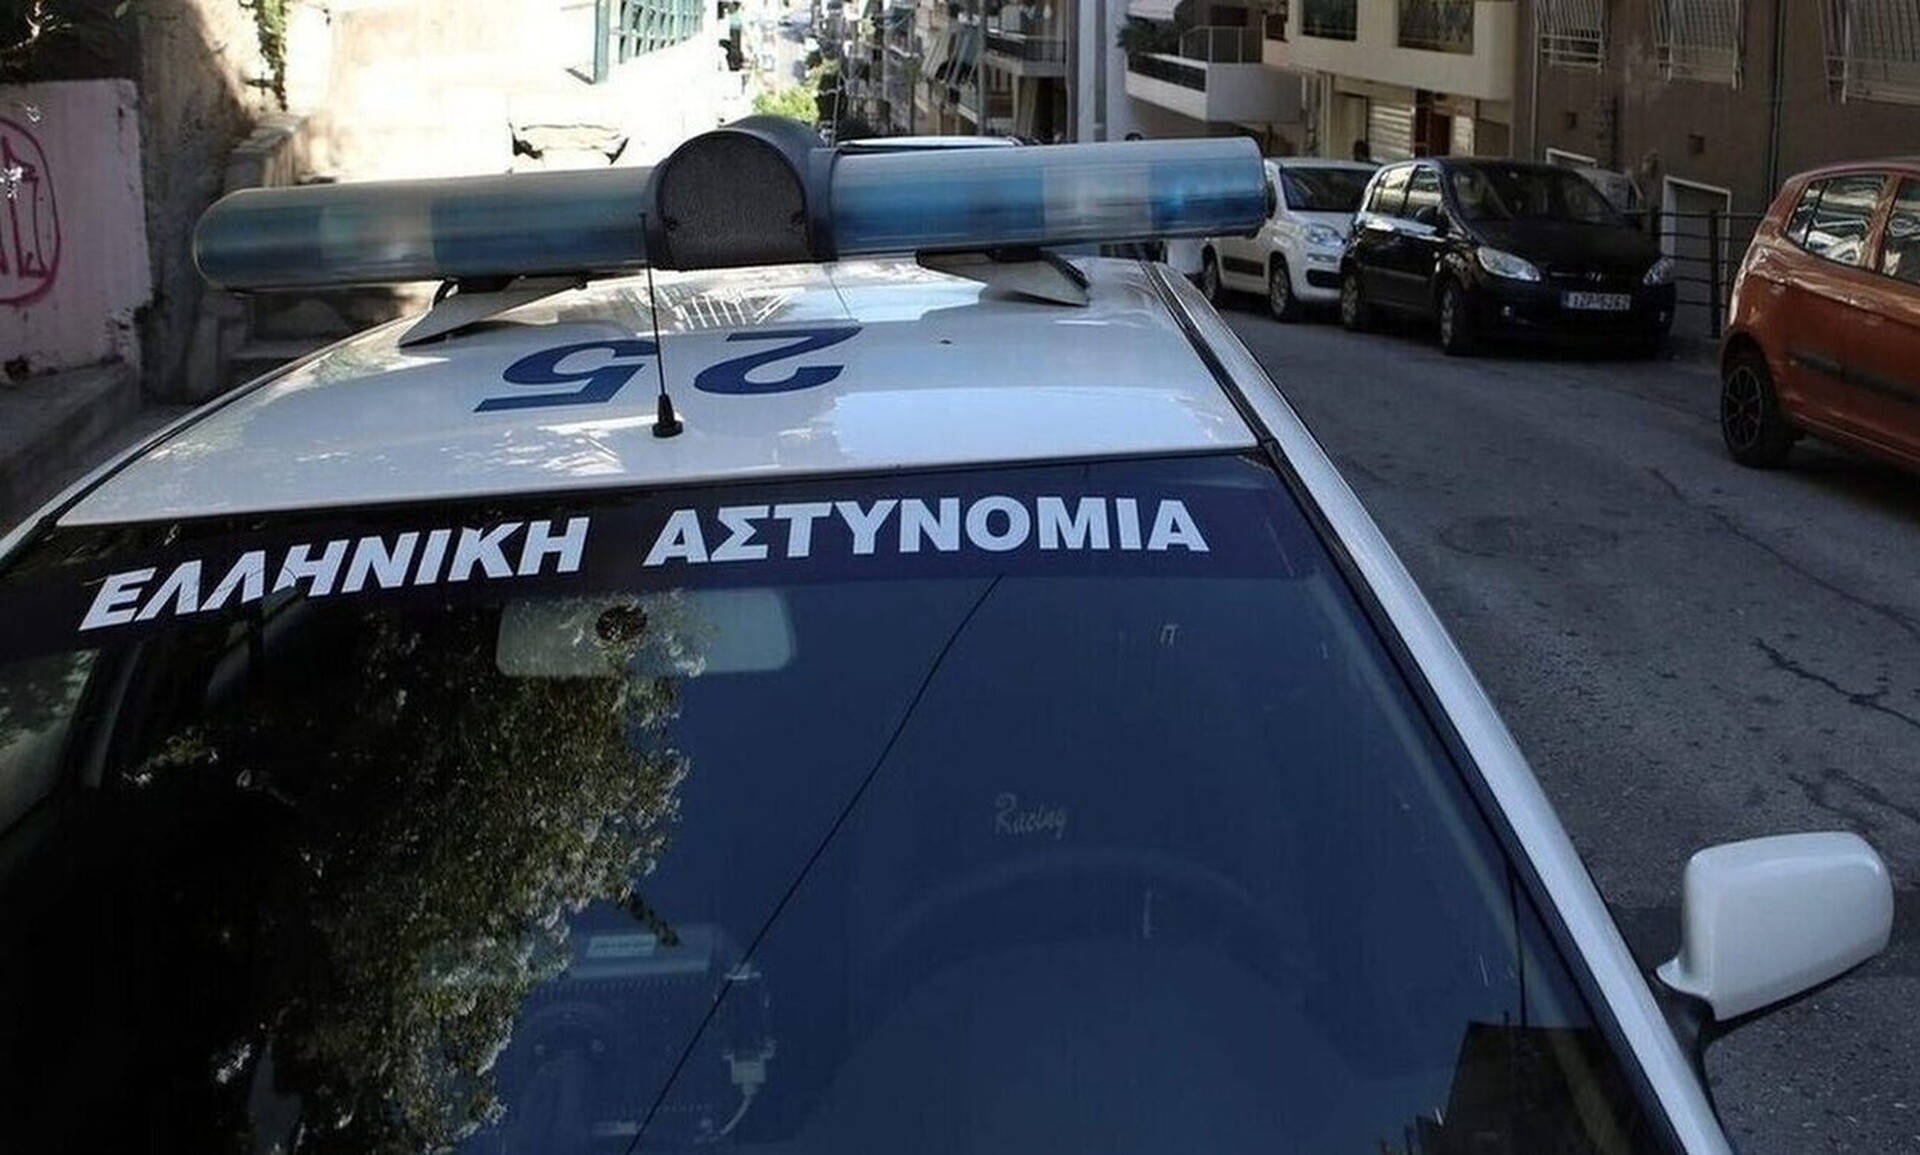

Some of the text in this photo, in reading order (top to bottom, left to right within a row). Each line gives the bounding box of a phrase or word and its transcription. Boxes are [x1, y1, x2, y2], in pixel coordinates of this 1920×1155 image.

[473, 326, 863, 413] 25
[78, 496, 1210, 632] ΕΛΛΗΝΙΚΗ ΑΣΤΥΝΟΜΙΑ
